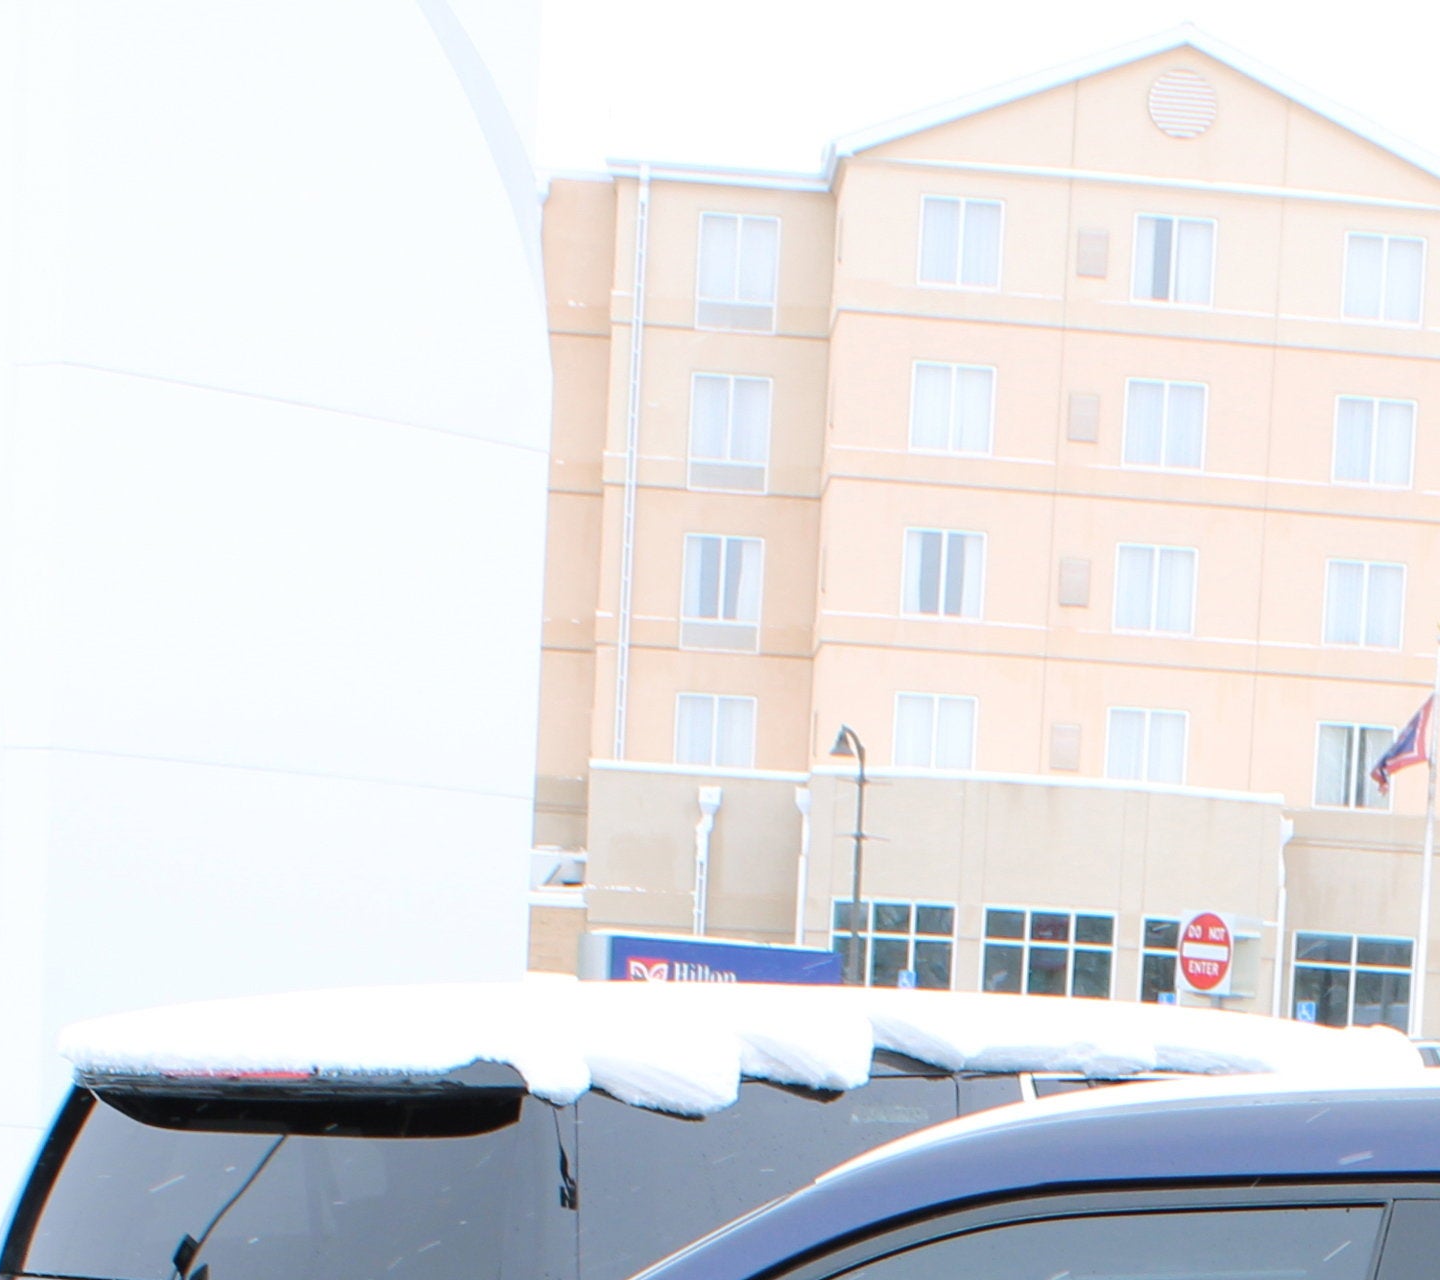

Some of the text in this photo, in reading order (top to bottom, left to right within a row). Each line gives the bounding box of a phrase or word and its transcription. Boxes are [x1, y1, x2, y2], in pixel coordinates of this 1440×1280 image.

[1187, 924, 1226, 941] DO NOT
[1188, 960, 1220, 976] ENTER
